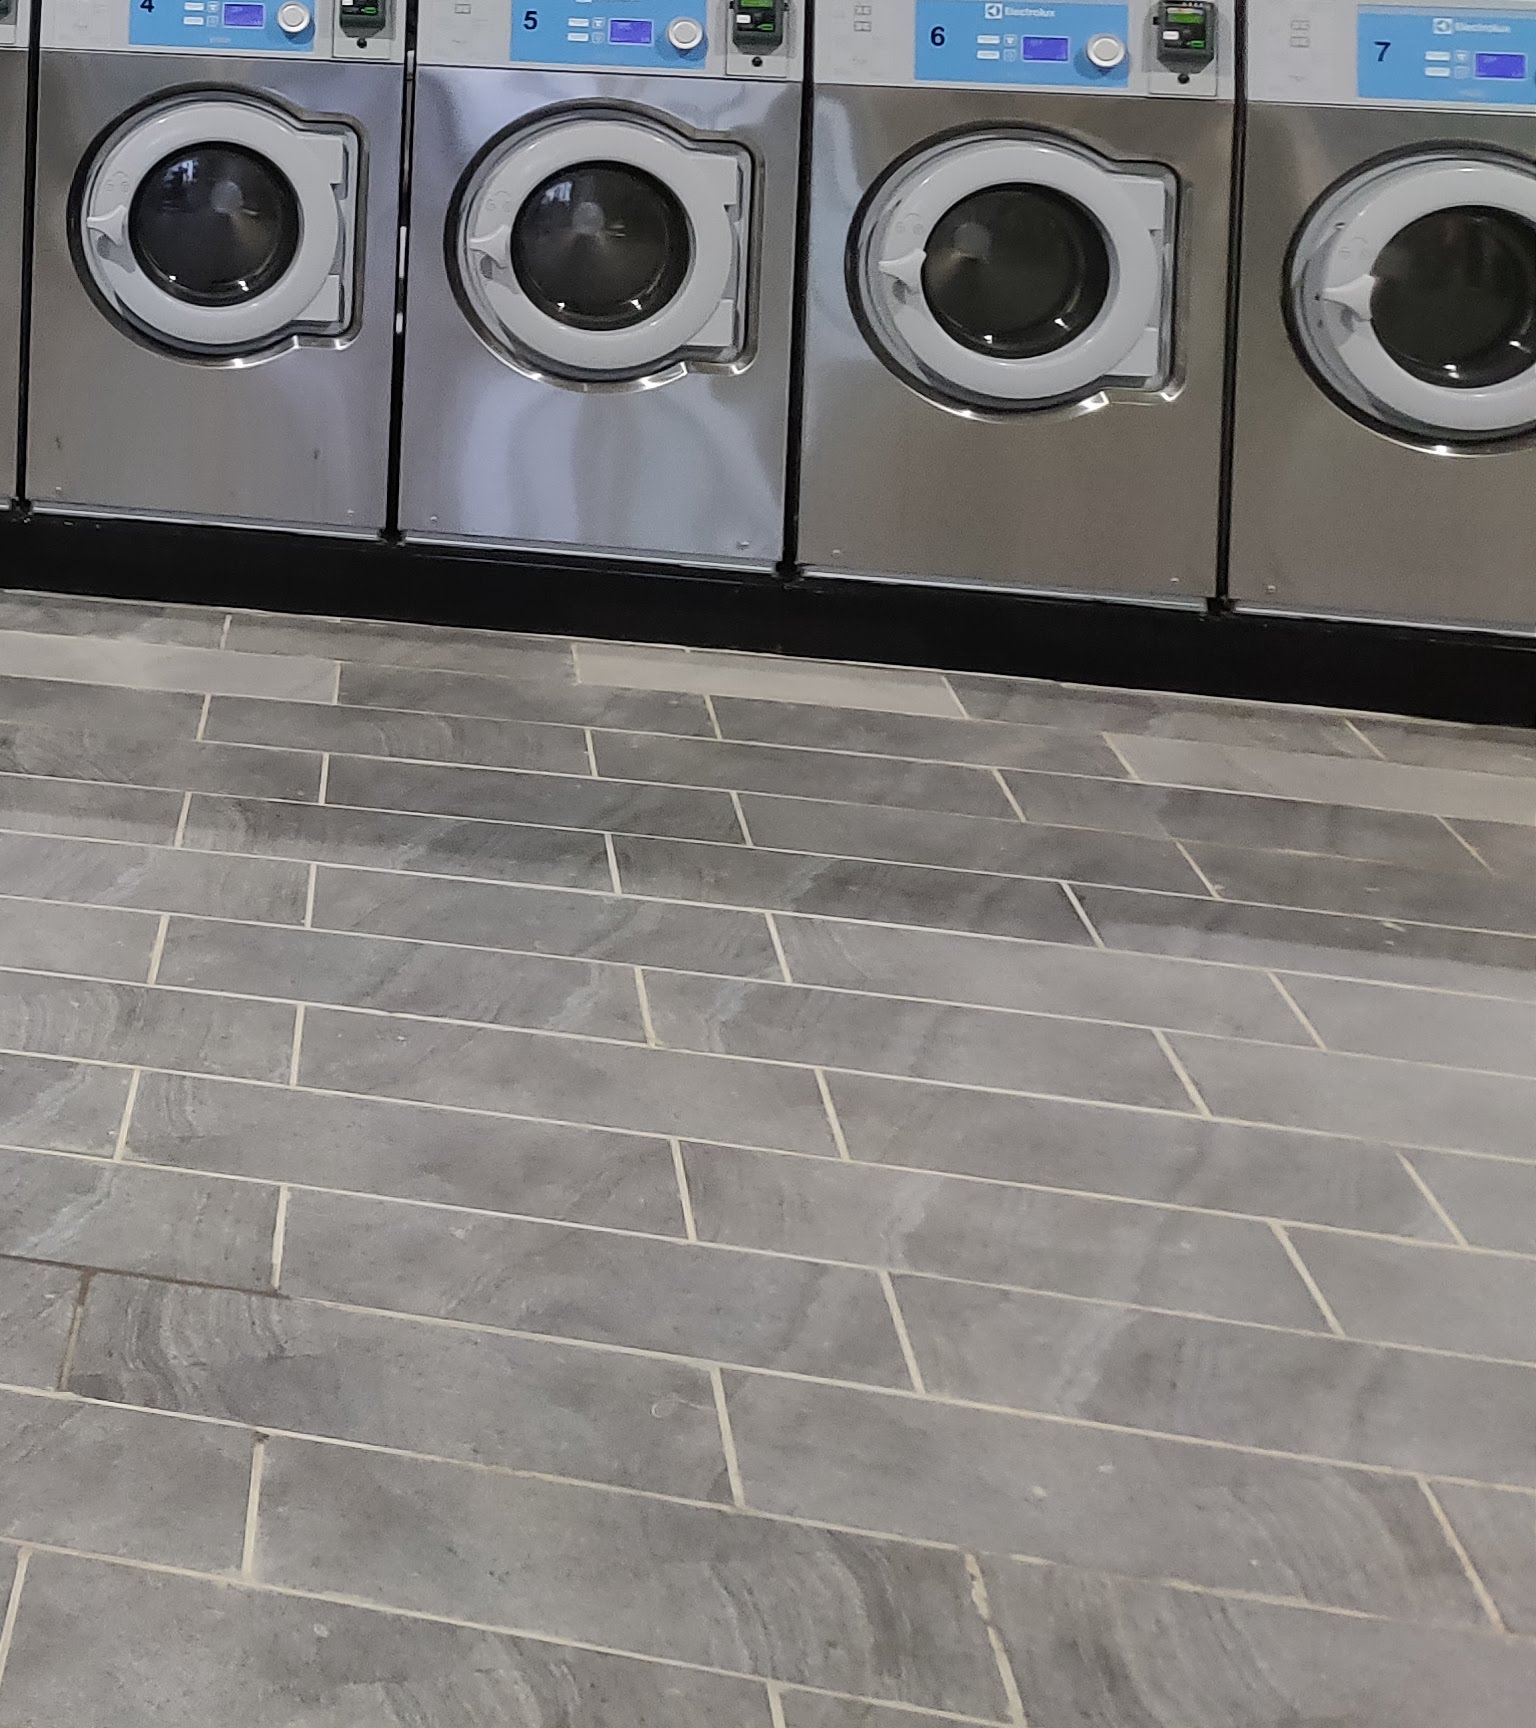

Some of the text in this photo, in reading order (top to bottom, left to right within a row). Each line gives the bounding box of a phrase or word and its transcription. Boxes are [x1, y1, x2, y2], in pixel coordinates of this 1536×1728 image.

[523, 10, 538, 30] 5
[1005, 6, 1055, 18] Electrolux
[930, 26, 945, 47] 6
[1374, 41, 1391, 62] 7
